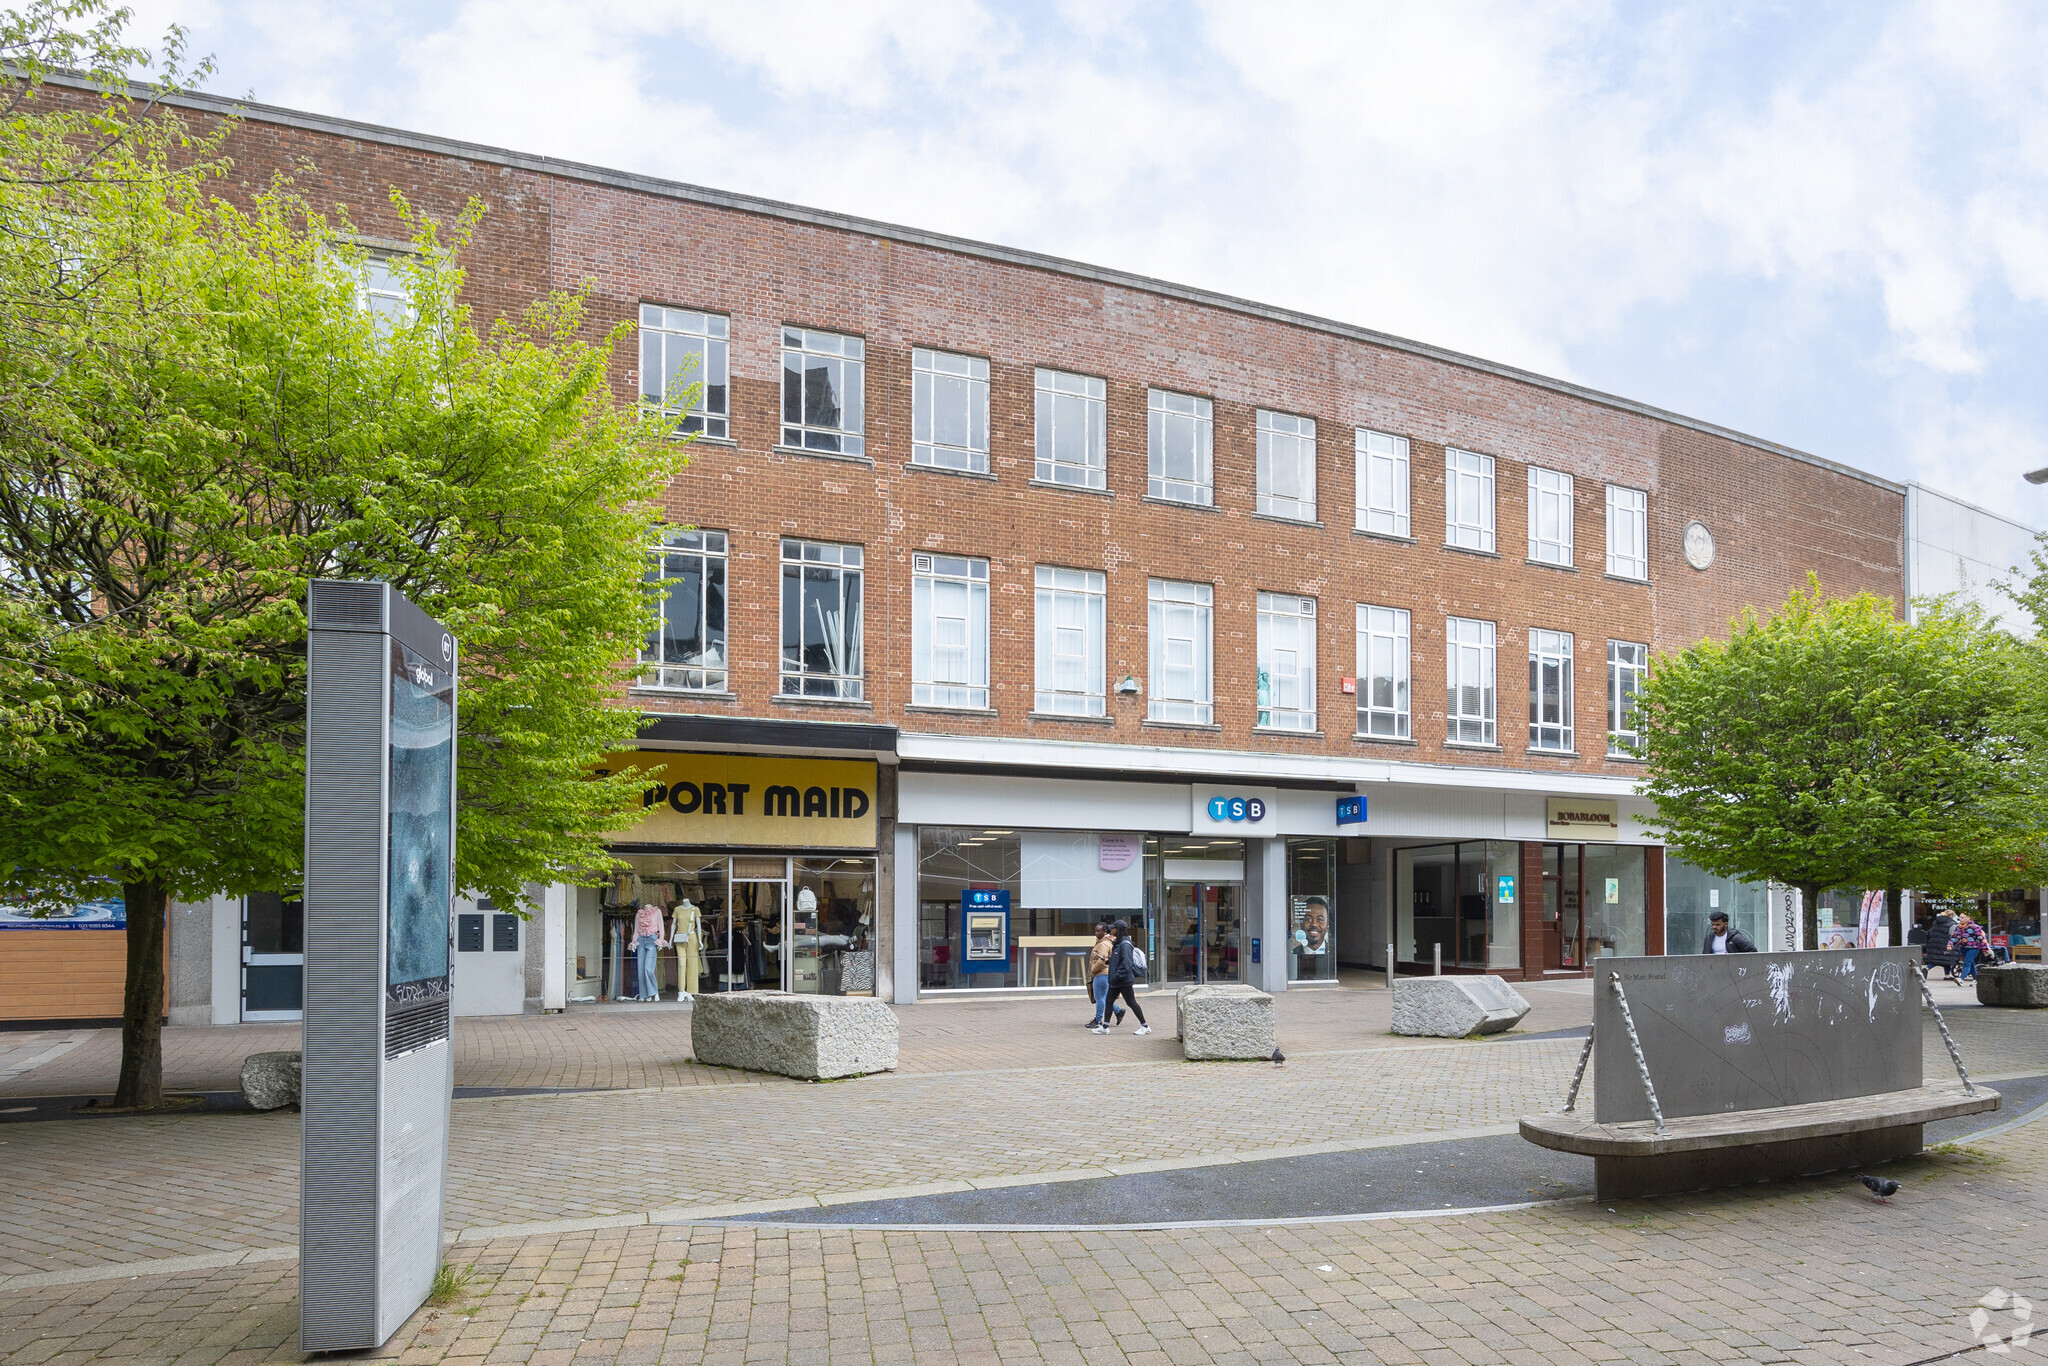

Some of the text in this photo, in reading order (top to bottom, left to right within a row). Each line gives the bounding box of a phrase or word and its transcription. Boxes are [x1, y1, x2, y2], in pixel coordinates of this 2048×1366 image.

[416, 665, 433, 686] global
[643, 781, 870, 818] PORT MAID
[1214, 800, 1262, 818] TSB
[1340, 804, 1358, 816] TSB
